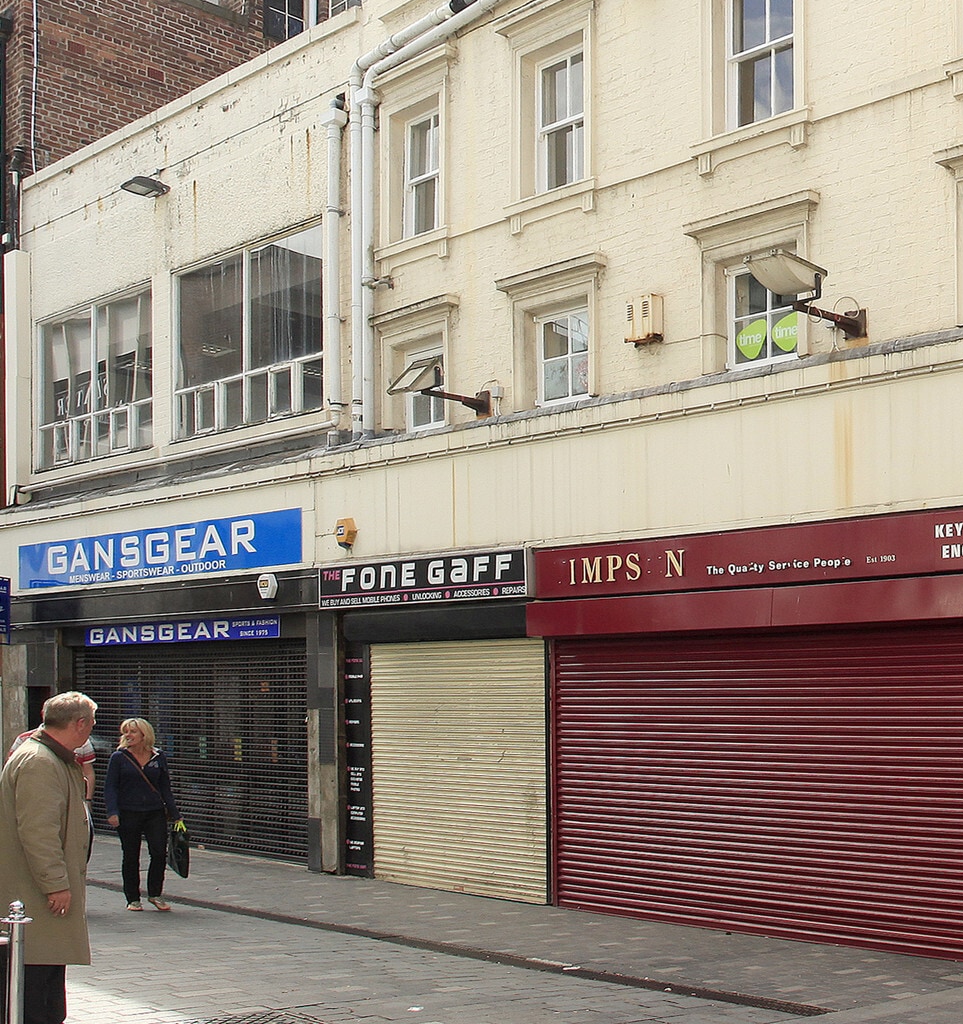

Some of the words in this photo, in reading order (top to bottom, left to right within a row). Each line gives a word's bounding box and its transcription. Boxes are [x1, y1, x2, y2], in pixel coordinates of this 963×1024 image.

[775, 325, 797, 339] time
[740, 333, 762, 346] time
[934, 522, 963, 539] KEY
[47, 519, 257, 575] GANSGEAR
[866, 555, 878, 564] Est
[880, 554, 896, 562] 1903
[69, 571, 110, 584] MENSWEAR
[116, 565, 175, 579] SPORTSWEAR
[181, 560, 226, 573] OUTDOOR
[323, 570, 340, 581] THE
[706, 565, 725, 575] The
[411, 592, 442, 601] UNLOCKING
[453, 588, 490, 598] ACCESSORIES
[501, 586, 526, 595] REPAIRS
[321, 599, 329, 607] WE
[330, 598, 340, 606] BUY
[340, 598, 350, 606] AND
[351, 597, 361, 605] SELL
[362, 596, 380, 604] MOBILE
[380, 594, 400, 603] PHONES
[90, 620, 230, 644] GANSGEAR
